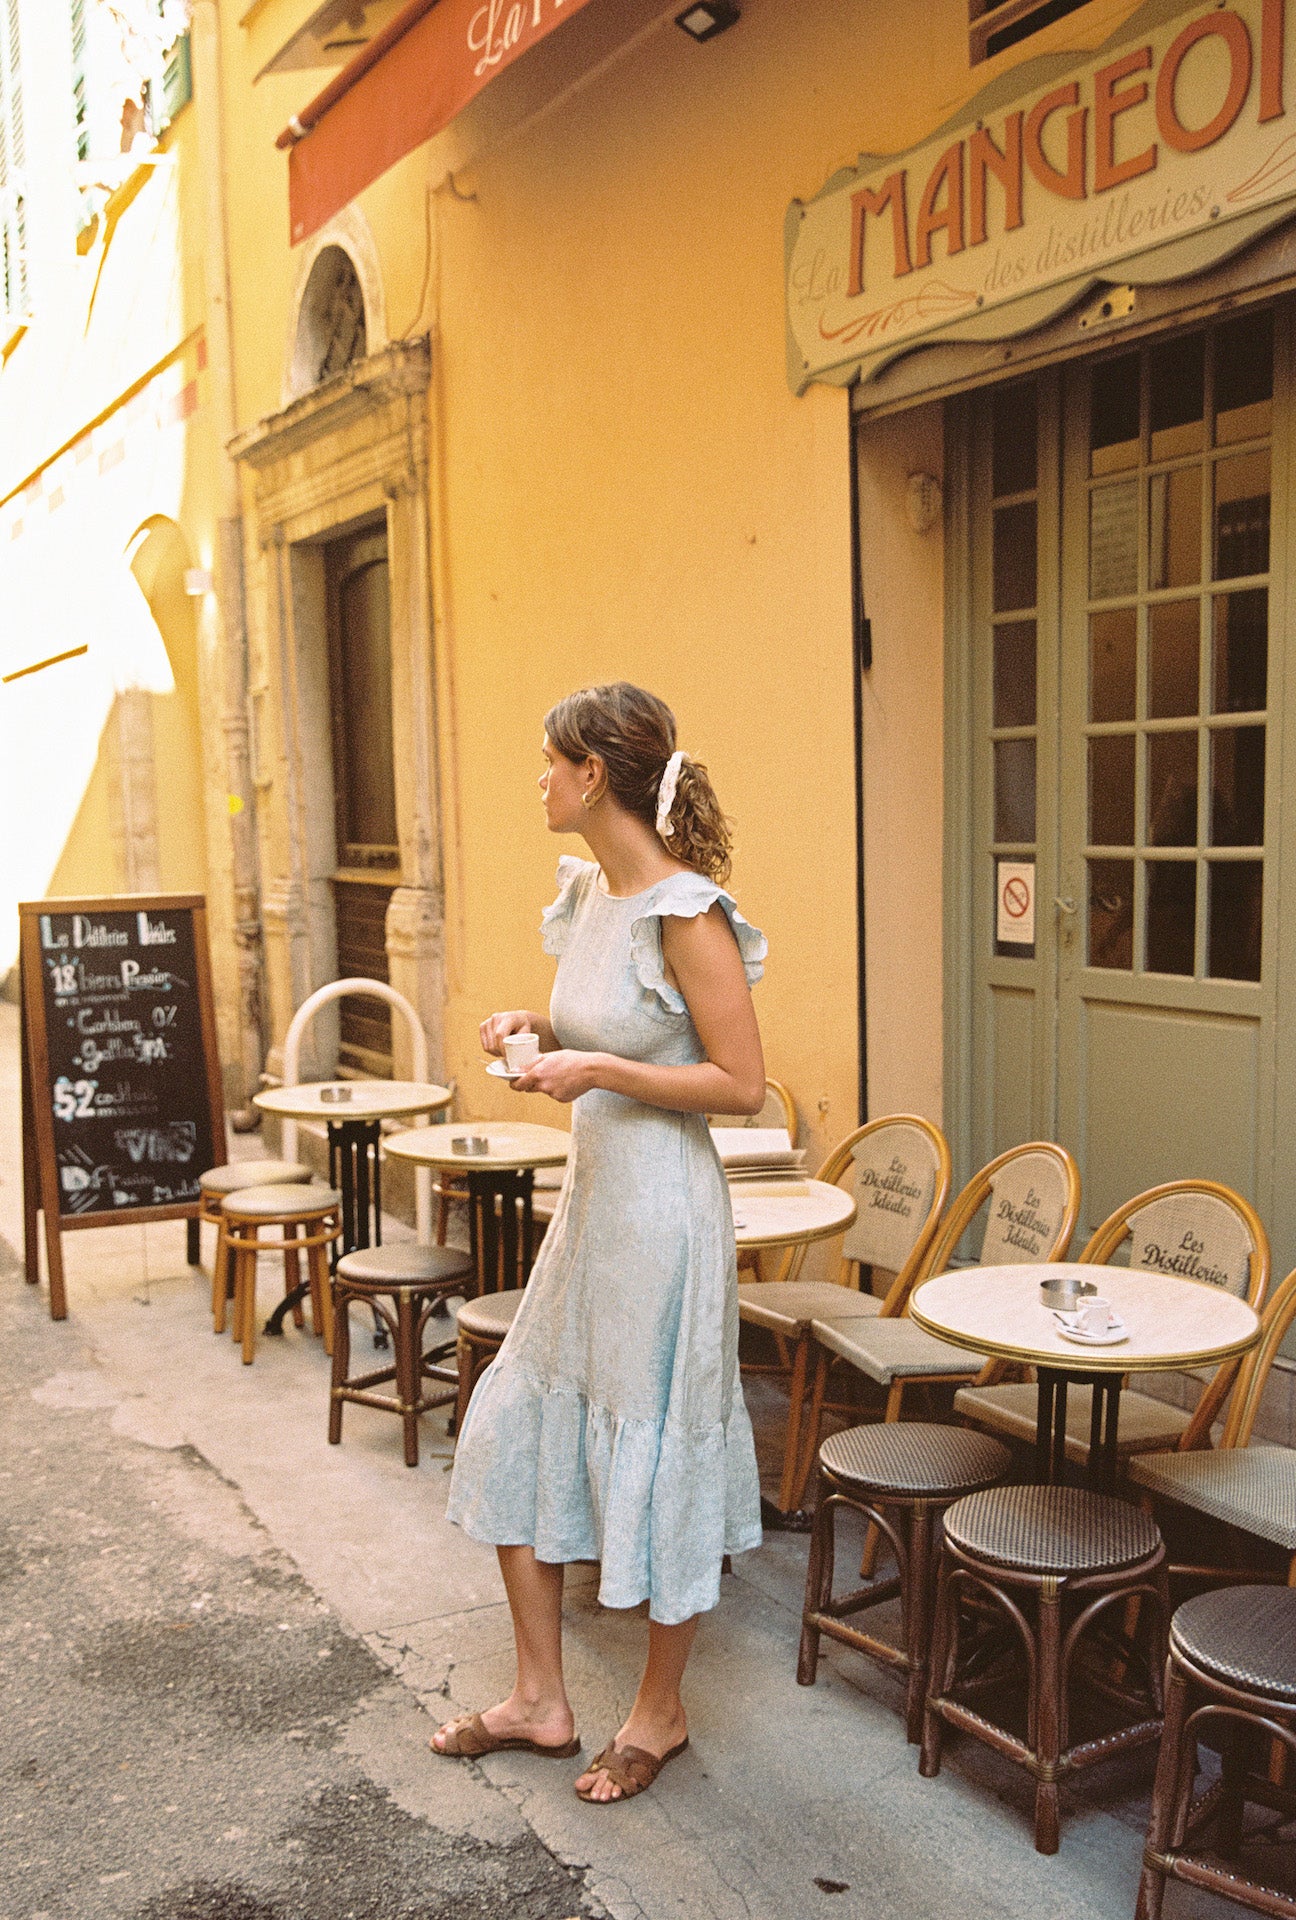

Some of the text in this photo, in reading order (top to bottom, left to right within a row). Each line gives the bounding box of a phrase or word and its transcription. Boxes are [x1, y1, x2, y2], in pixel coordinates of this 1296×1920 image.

[467, 0, 527, 76] La
[984, 185, 1211, 294] des distilleries
[51, 963, 79, 996] 18
[53, 1078, 97, 1119] 52
[889, 1155, 908, 1175] Les
[1024, 1187, 1041, 1209] Les
[1178, 1230, 1205, 1254] Les
[1141, 1243, 1228, 1286] Distilleries
